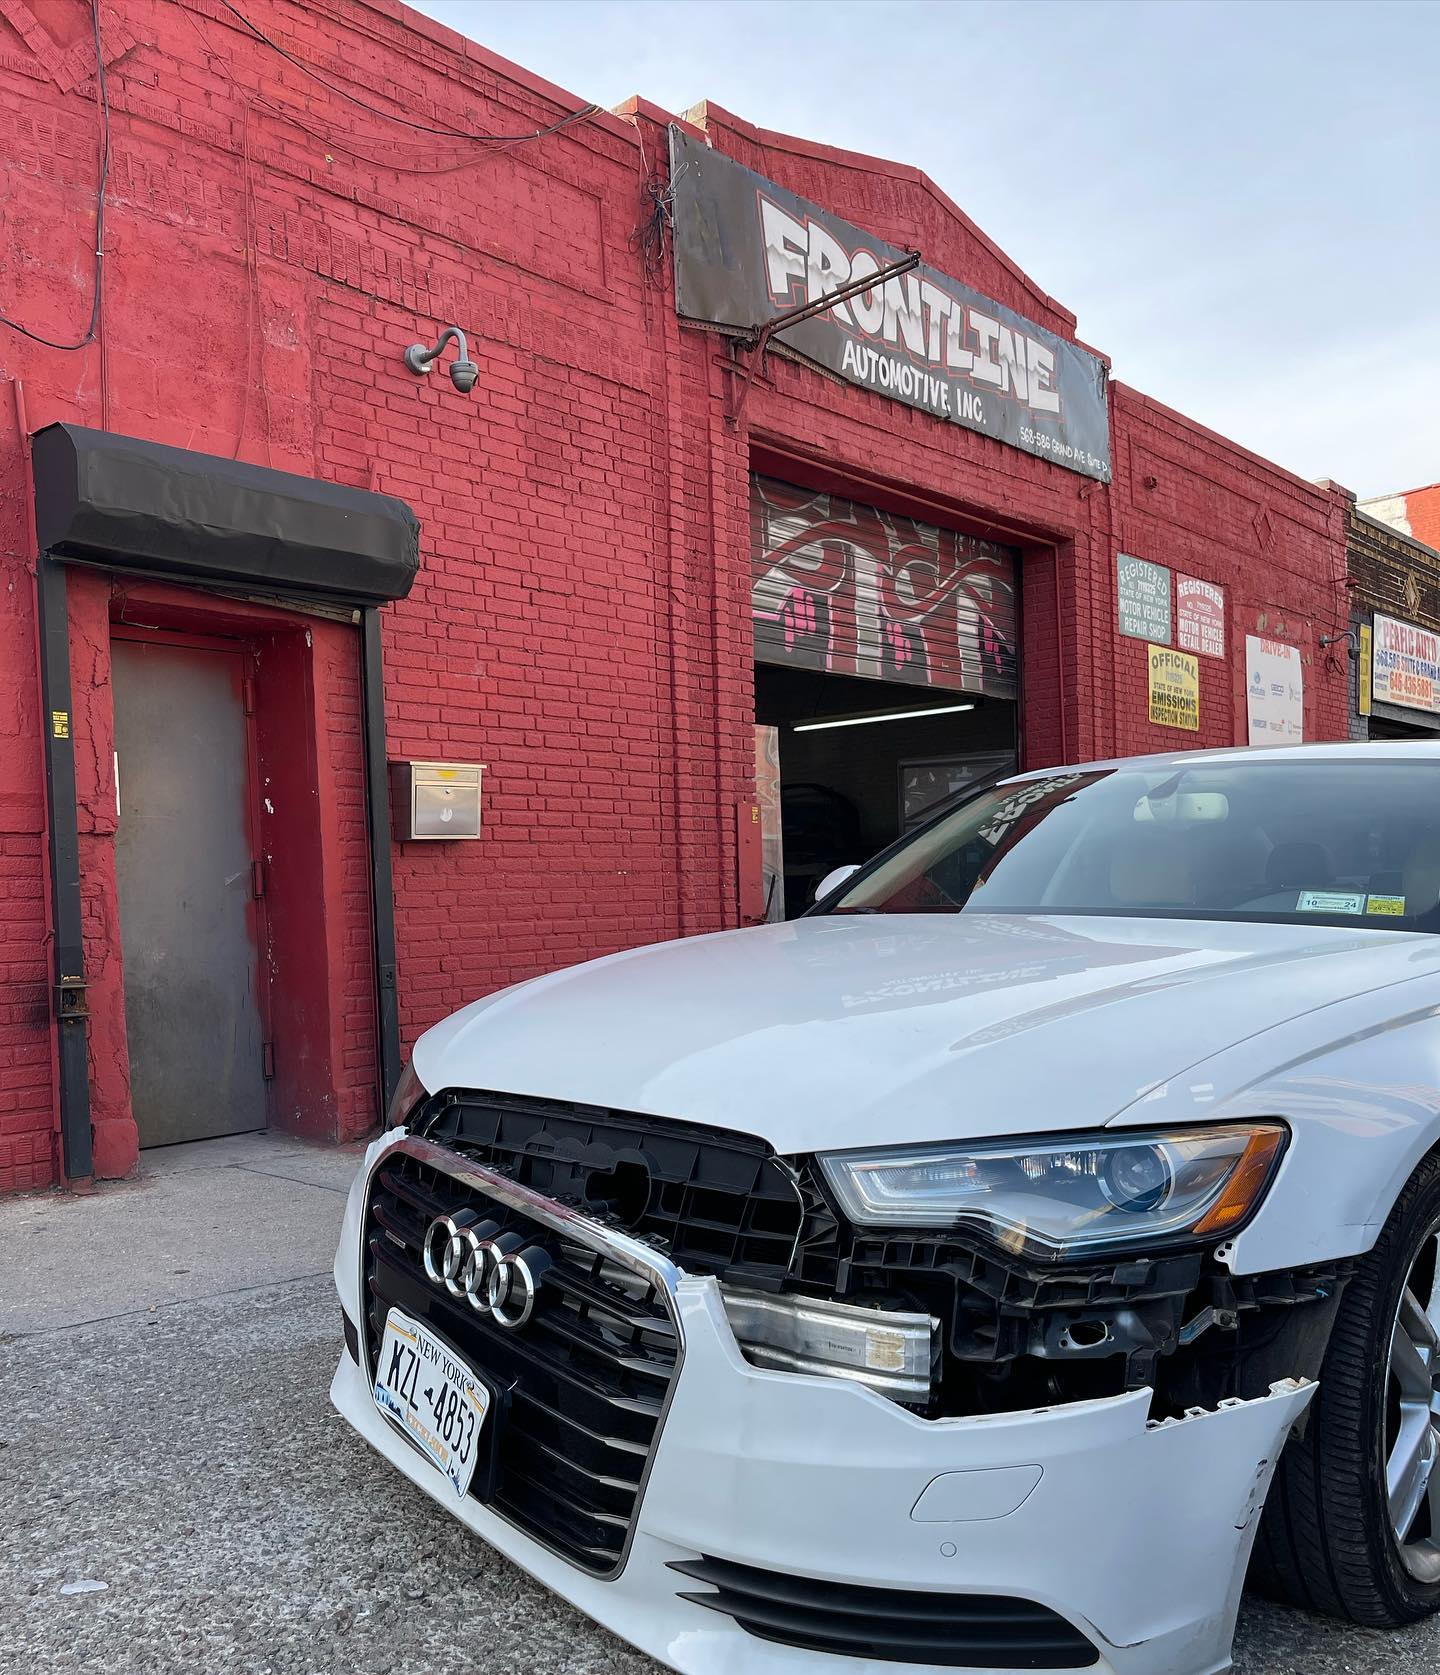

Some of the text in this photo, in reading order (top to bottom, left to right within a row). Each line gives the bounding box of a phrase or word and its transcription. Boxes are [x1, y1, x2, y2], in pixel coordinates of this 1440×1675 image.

[759, 196, 1061, 414] FRONTLINE
[842, 340, 987, 424] AUTOMOTIVE INC.
[1020, 426, 1051, 449] 568-586
[1051, 438, 1073, 458] GRAND
[1119, 562, 1168, 596] REGISTERED
[1178, 580, 1224, 609] REGISTERED
[1119, 598, 1169, 624] MOTOR VEHICLE
[1124, 616, 1166, 640] REPAIR SHOP
[1179, 618, 1223, 642] MOTOR VEHICLE
[1179, 631, 1223, 657] RETAIL DEALER
[1415, 632, 1437, 662] AUTO
[1151, 652, 1196, 680] OFFICIAL
[1151, 690, 1196, 712] EMISSIONS
[1150, 705, 1197, 728] INSPECTION STATION
[416, 1334, 468, 1395] NEW YORK
[387, 1339, 475, 1464] KZL 4853
